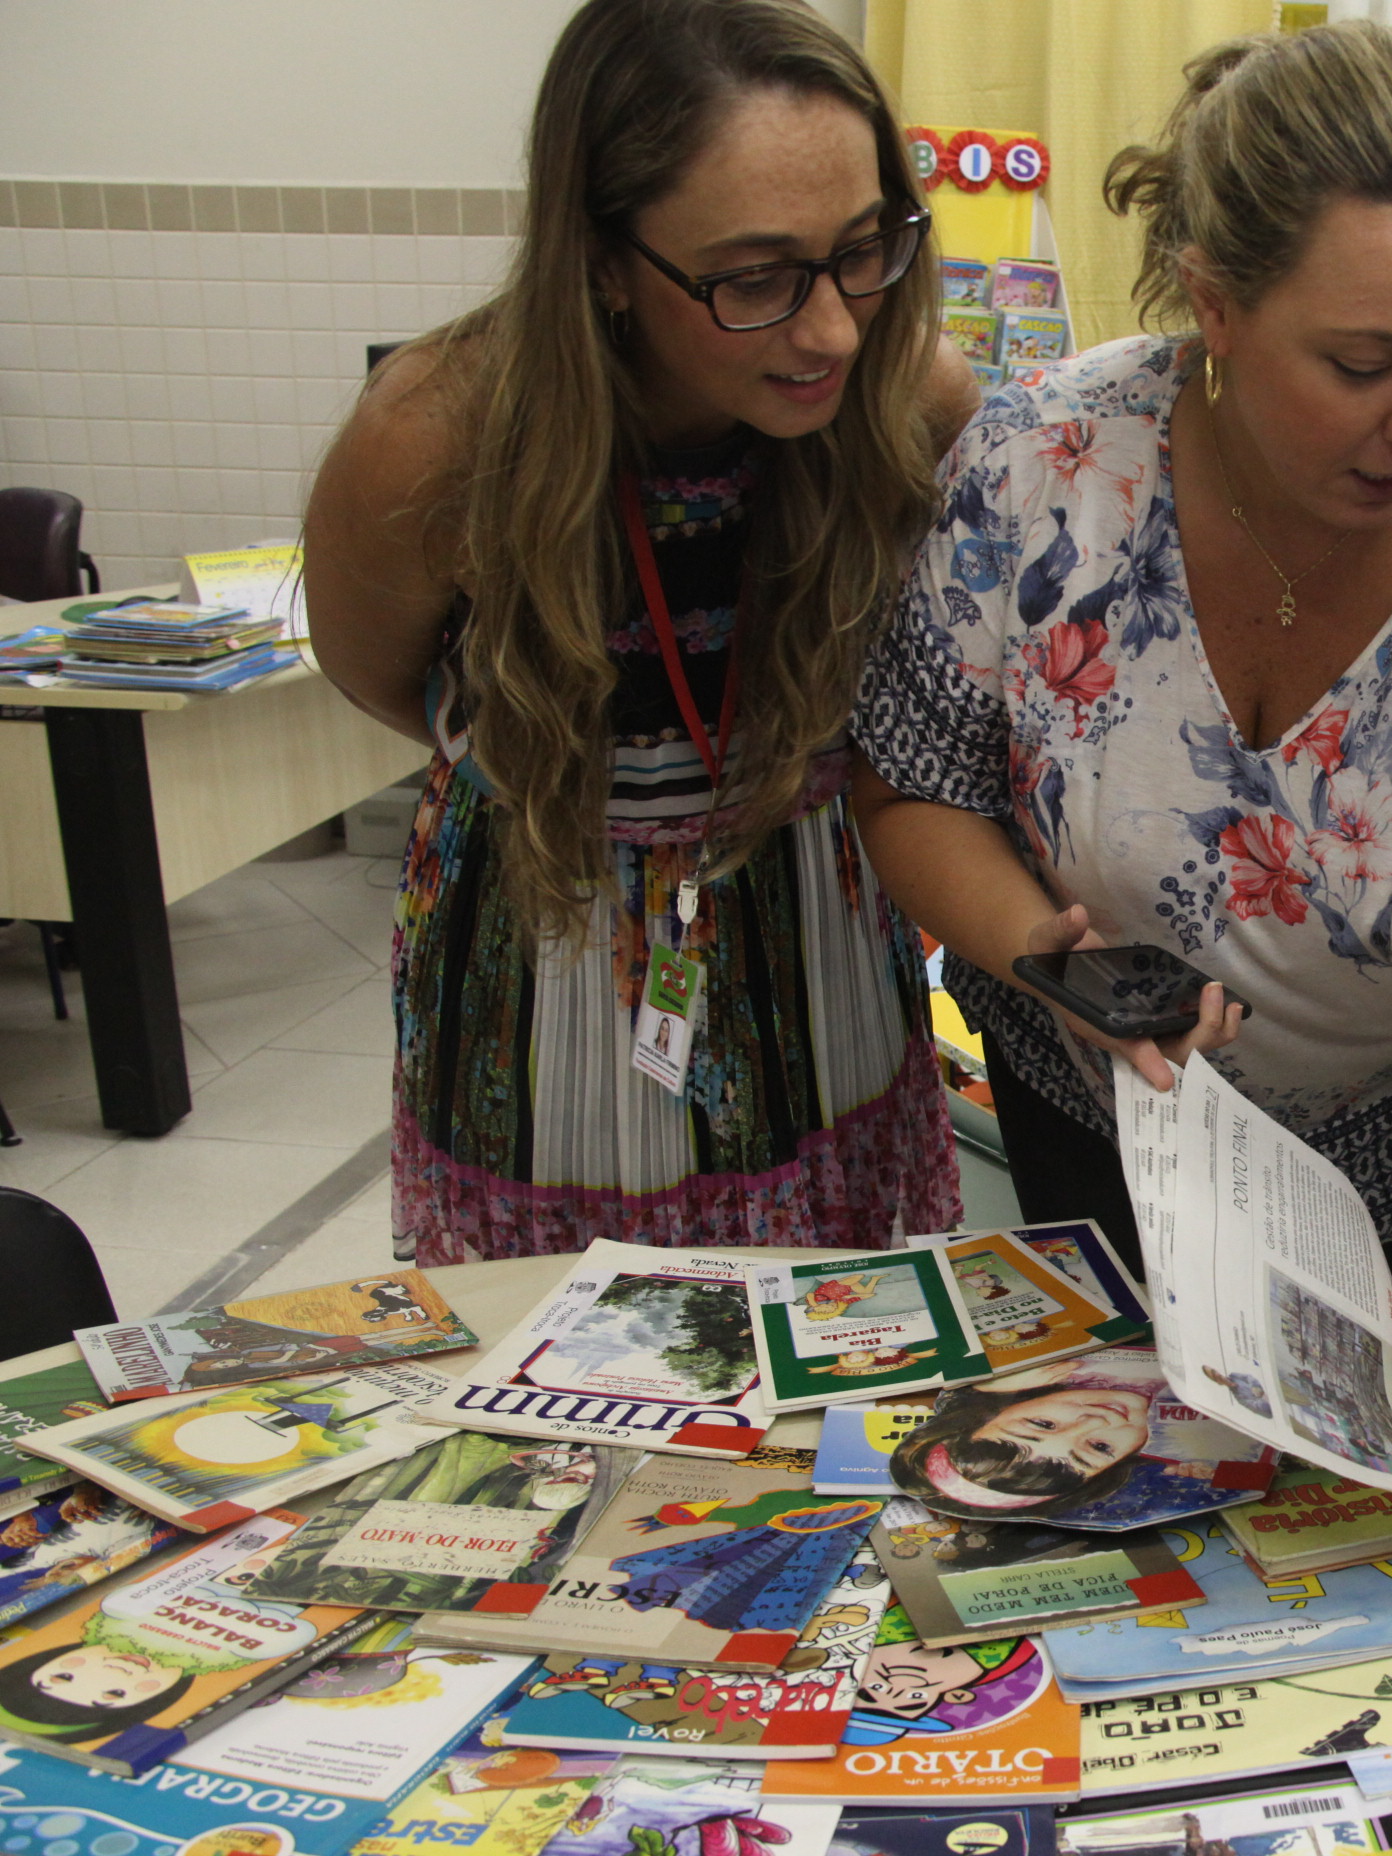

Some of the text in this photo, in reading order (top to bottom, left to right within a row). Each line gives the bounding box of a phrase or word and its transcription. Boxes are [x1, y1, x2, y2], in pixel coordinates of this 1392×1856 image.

[1232, 1114, 1249, 1213] PONTO FINAL
[1264, 1202, 1274, 1215] de
[658, 1264, 738, 1280] Adormecida
[690, 1257, 740, 1270] Nevada
[529, 1299, 569, 1334] Troca-troca
[552, 1305, 578, 1329] Projeto
[1001, 1306, 1047, 1322] Beto
[820, 1324, 906, 1342] Tagarela
[848, 1337, 882, 1347] Bia
[344, 1368, 419, 1398] menino
[550, 1422, 631, 1439] Contos de
[626, 1486, 721, 1501] RUTH ROCHA
[628, 1480, 729, 1496] OTÁVIO ROTH
[398, 1559, 498, 1575] HERBERTO
[1035, 1565, 1077, 1579] STELLA
[128, 1556, 215, 1601] Troca-troca
[163, 1567, 217, 1598] Projeto
[972, 1573, 1118, 1602] FICA DE FORA!
[552, 1600, 610, 1612] LIVRO
[967, 1599, 1025, 1616] MEDO
[1033, 1591, 1075, 1607] TEM
[1198, 1622, 1322, 1645] José Paulo Paes
[1235, 1634, 1296, 1647] Poemas de
[310, 1637, 349, 1662] CARRASCO
[1199, 1690, 1222, 1707] O
[1232, 1686, 1260, 1701] E
[1131, 1694, 1184, 1717] PÉ
[1100, 1708, 1246, 1742] JOÃO
[1144, 1742, 1222, 1763] César
[220, 1755, 265, 1768] Moderna
[267, 1763, 303, 1776] Editora
[845, 1747, 1054, 1779] OTÁRIO
[903, 1775, 1041, 1787] onfissões de um
